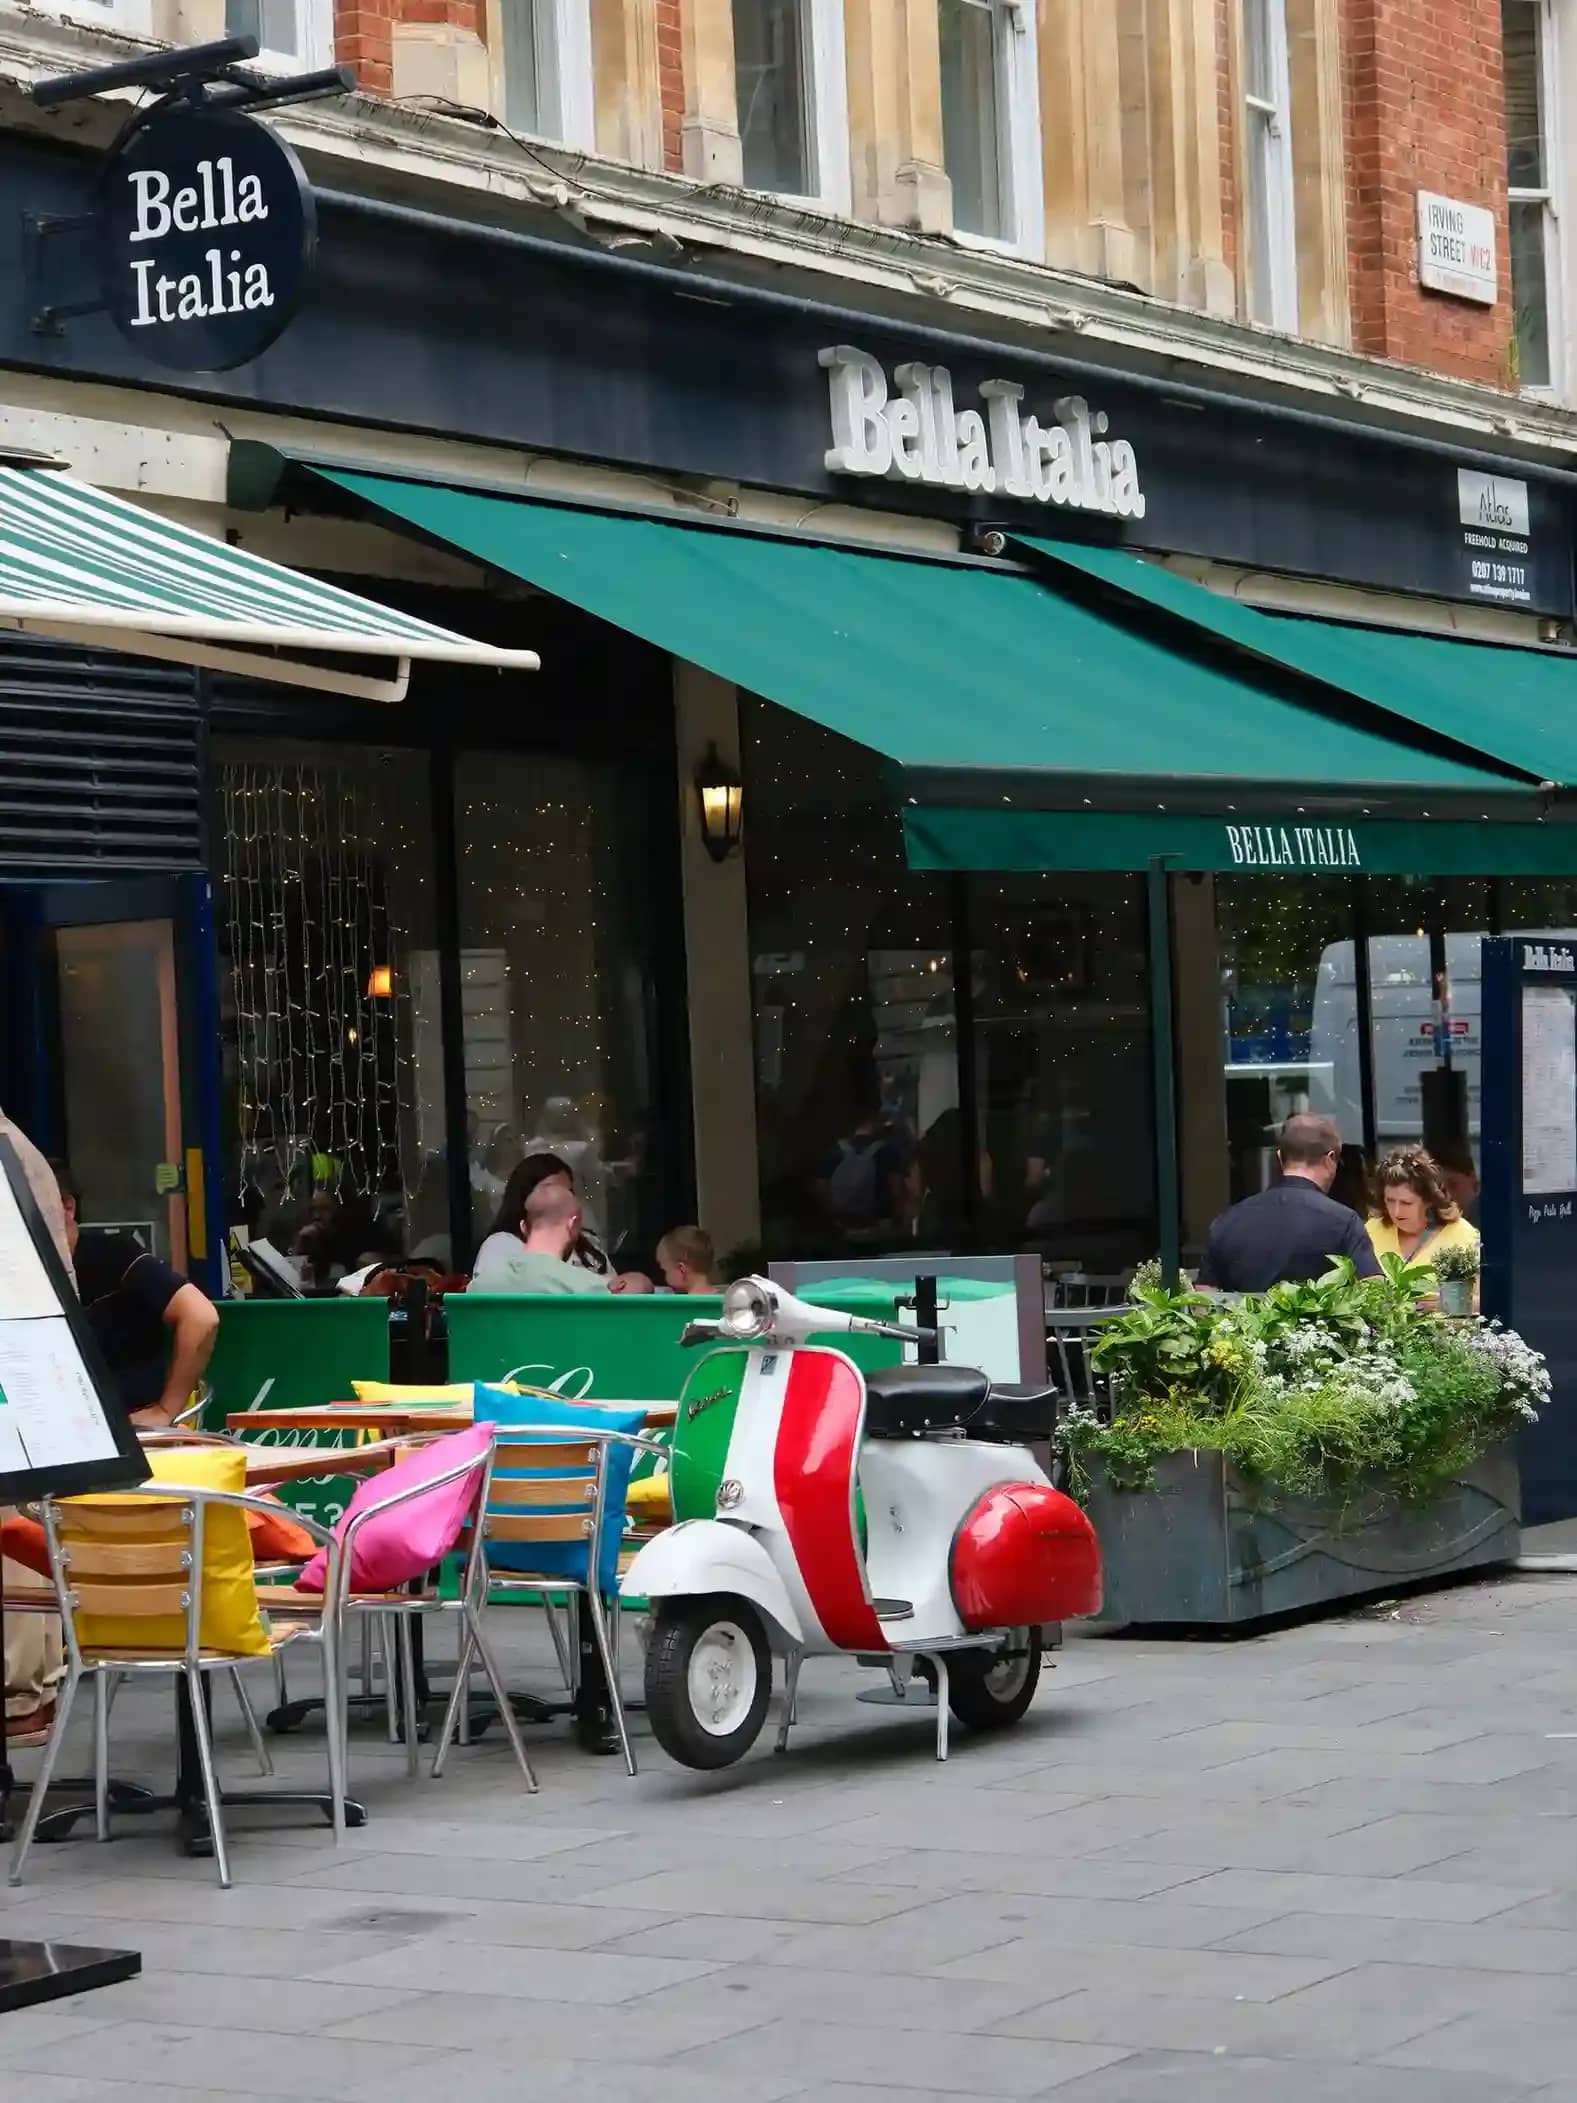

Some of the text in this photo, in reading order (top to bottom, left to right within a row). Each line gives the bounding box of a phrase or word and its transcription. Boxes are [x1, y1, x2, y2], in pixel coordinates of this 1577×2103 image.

[128, 157, 268, 241] Bella
[1428, 203, 1463, 234] IRVING
[1430, 232, 1491, 271] STREET WC2
[130, 249, 274, 325] Italia
[818, 345, 1145, 519] Bella Italia
[1479, 480, 1512, 526] Atlas
[1464, 532, 1529, 554] FREEHOLD ACQUIRED
[1471, 560, 1525, 585] 0207 139 1717
[1225, 825, 1361, 866] BELLA ITALIA
[1522, 944, 1575, 971] Bella Italia
